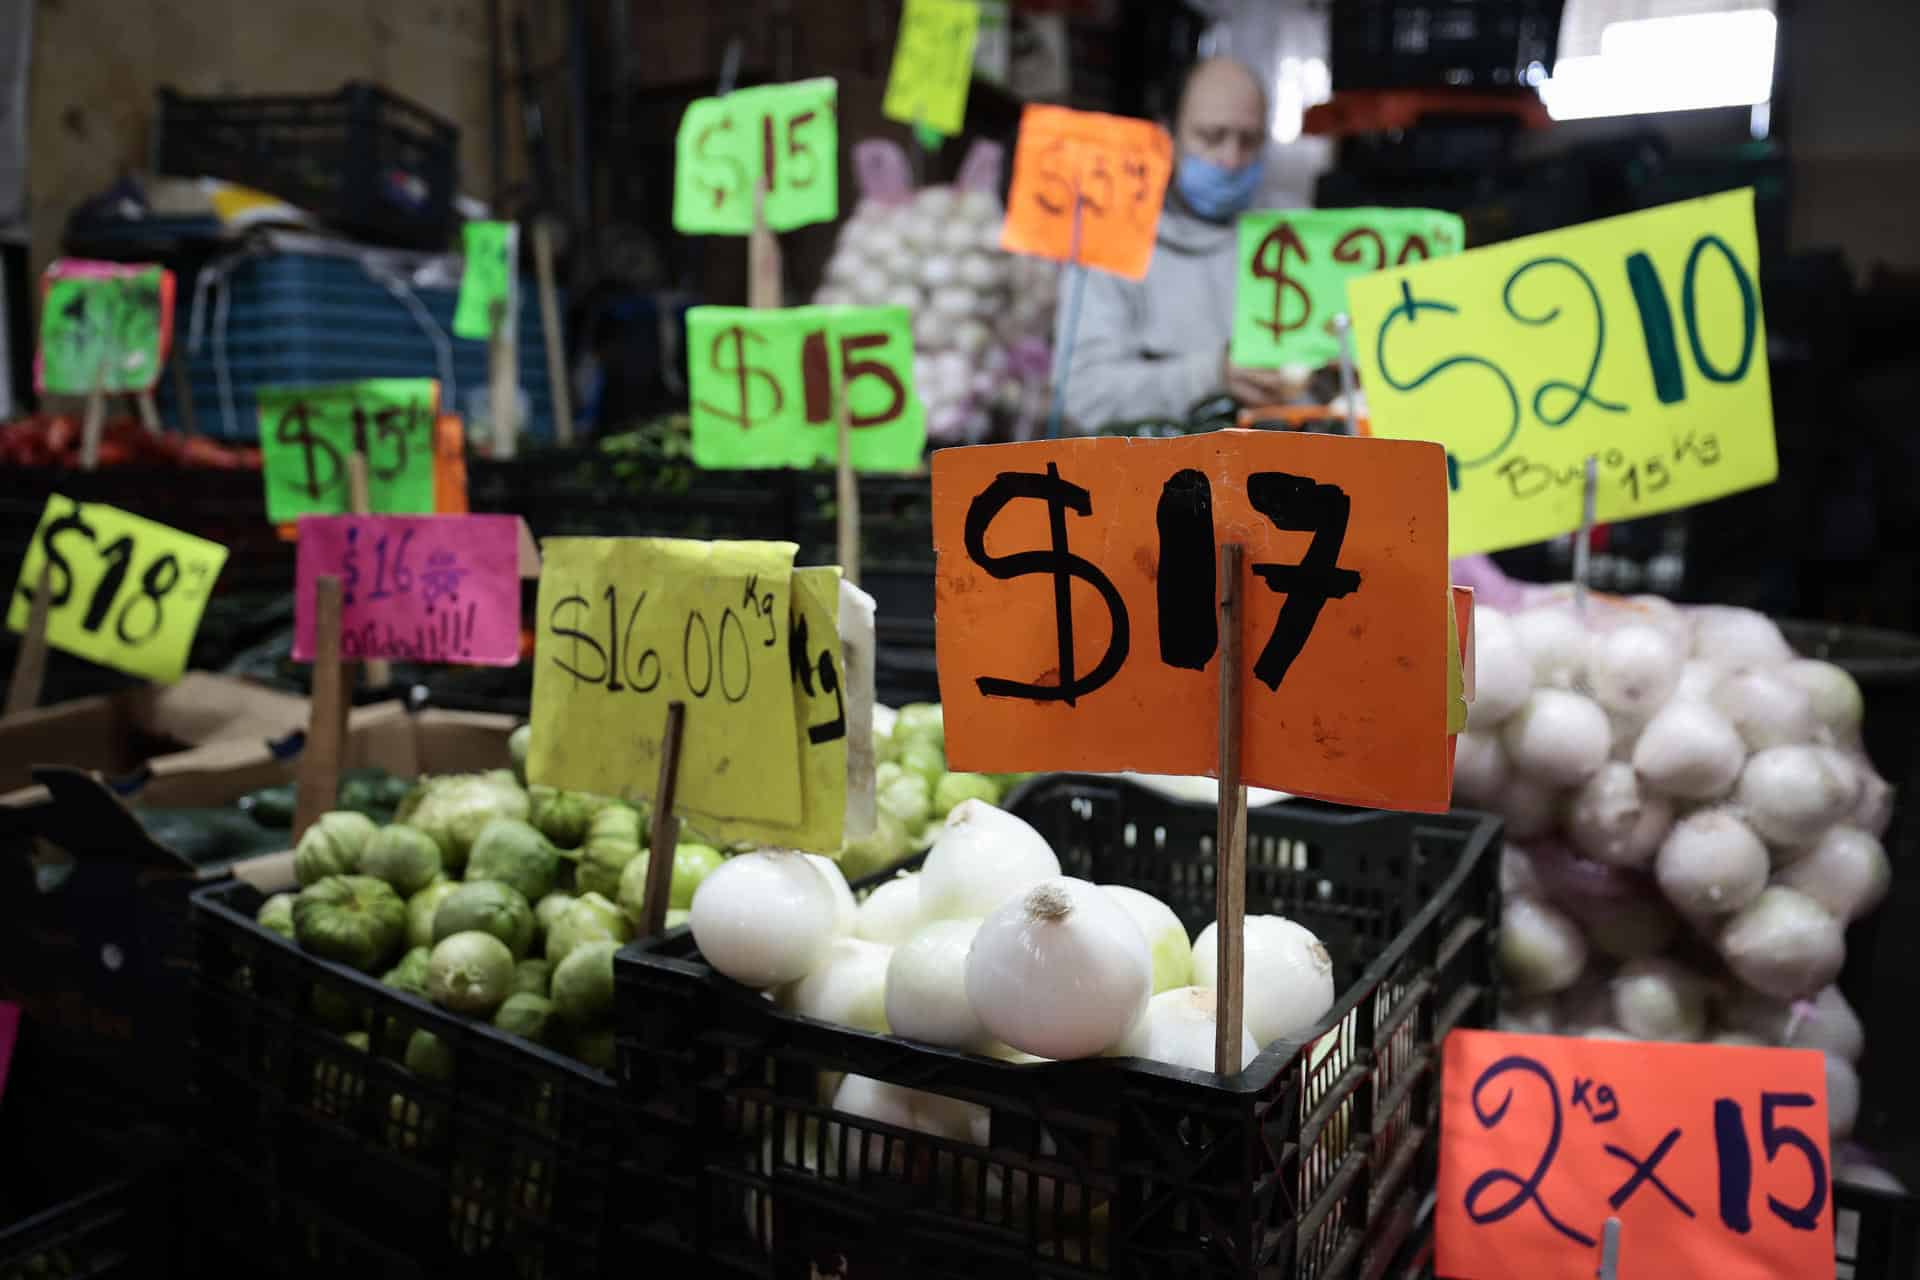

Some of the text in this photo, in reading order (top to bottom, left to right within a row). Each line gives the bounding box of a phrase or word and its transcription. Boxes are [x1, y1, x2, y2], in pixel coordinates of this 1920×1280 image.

[693, 325, 906, 431] $15
[1377, 234, 1758, 492] $210
[17, 498, 180, 646] $18
[964, 461, 1362, 707] $17
[1464, 1054, 1597, 1249] 2
[1714, 1091, 1828, 1234] 15
